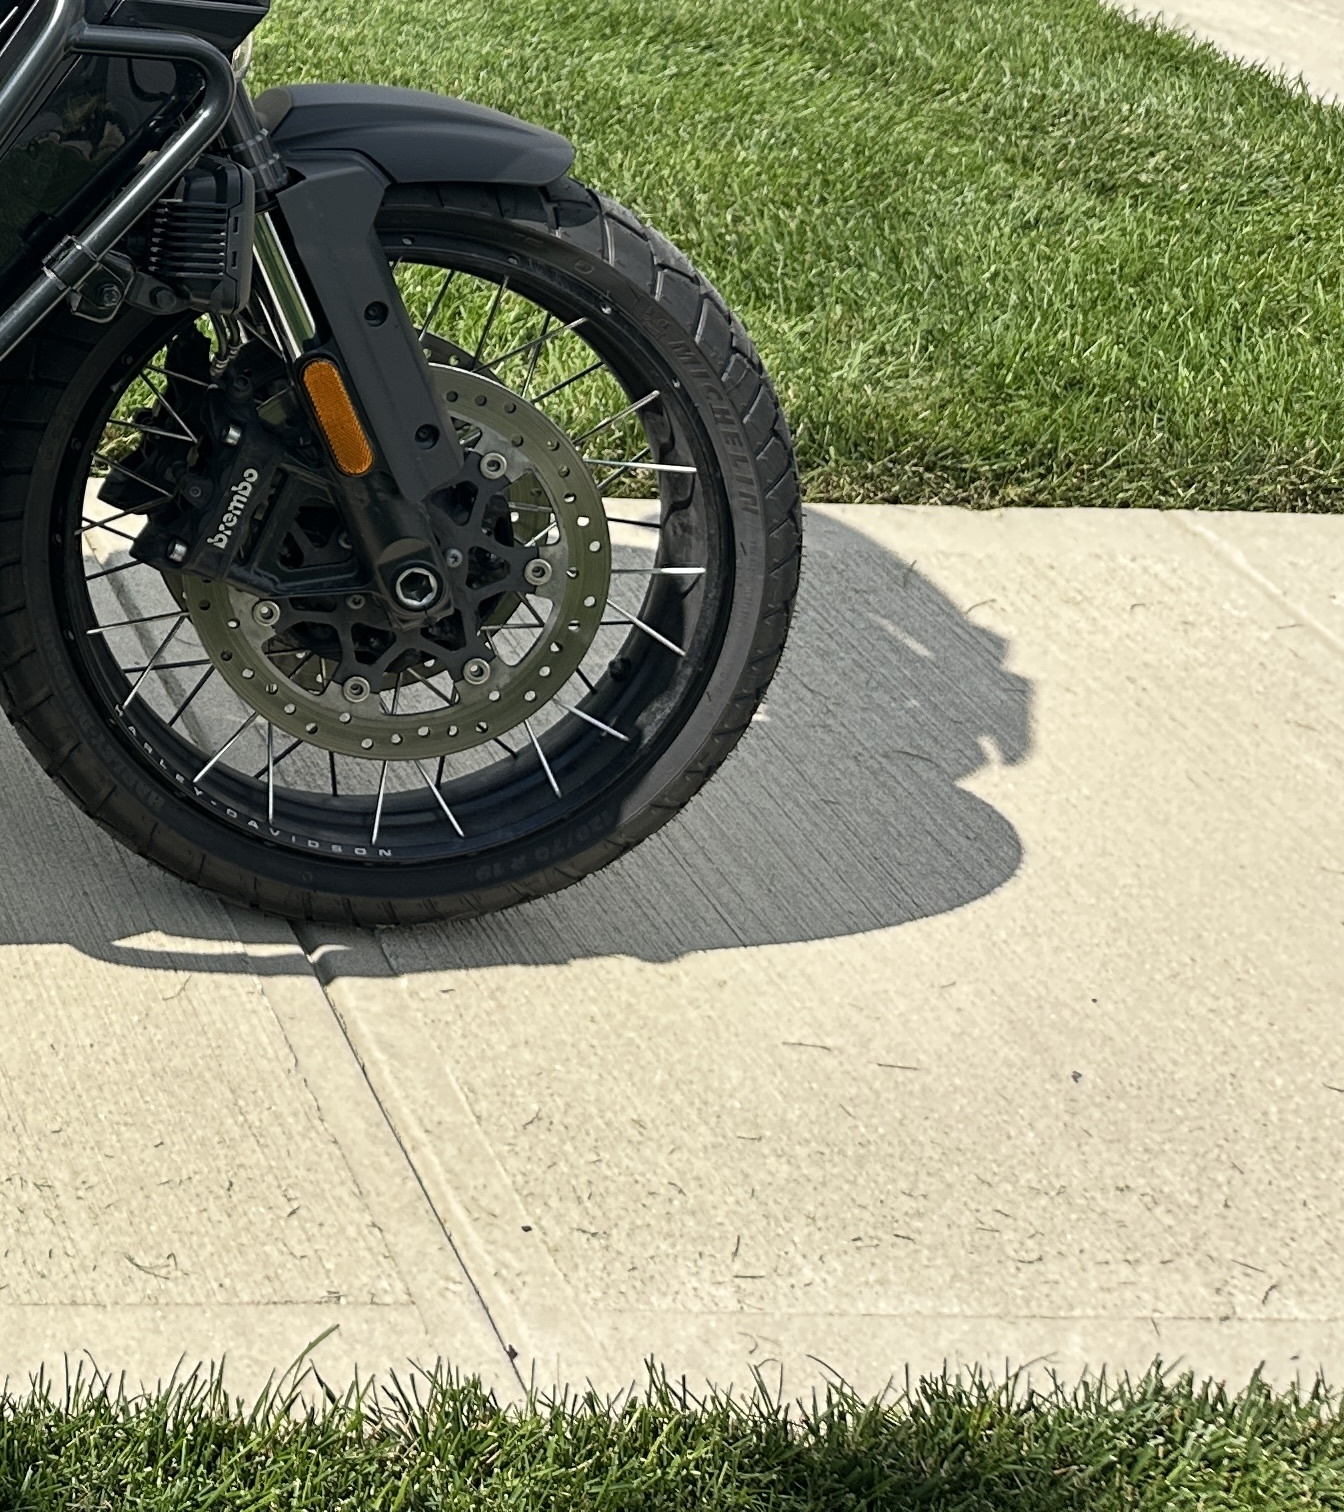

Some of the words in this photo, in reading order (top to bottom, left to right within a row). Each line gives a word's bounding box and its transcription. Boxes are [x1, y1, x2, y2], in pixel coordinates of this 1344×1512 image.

[668, 338, 759, 515] MICHELIN
[207, 467, 259, 550] brembo
[114, 702, 394, 858] HARLEY-DAVIDSON
